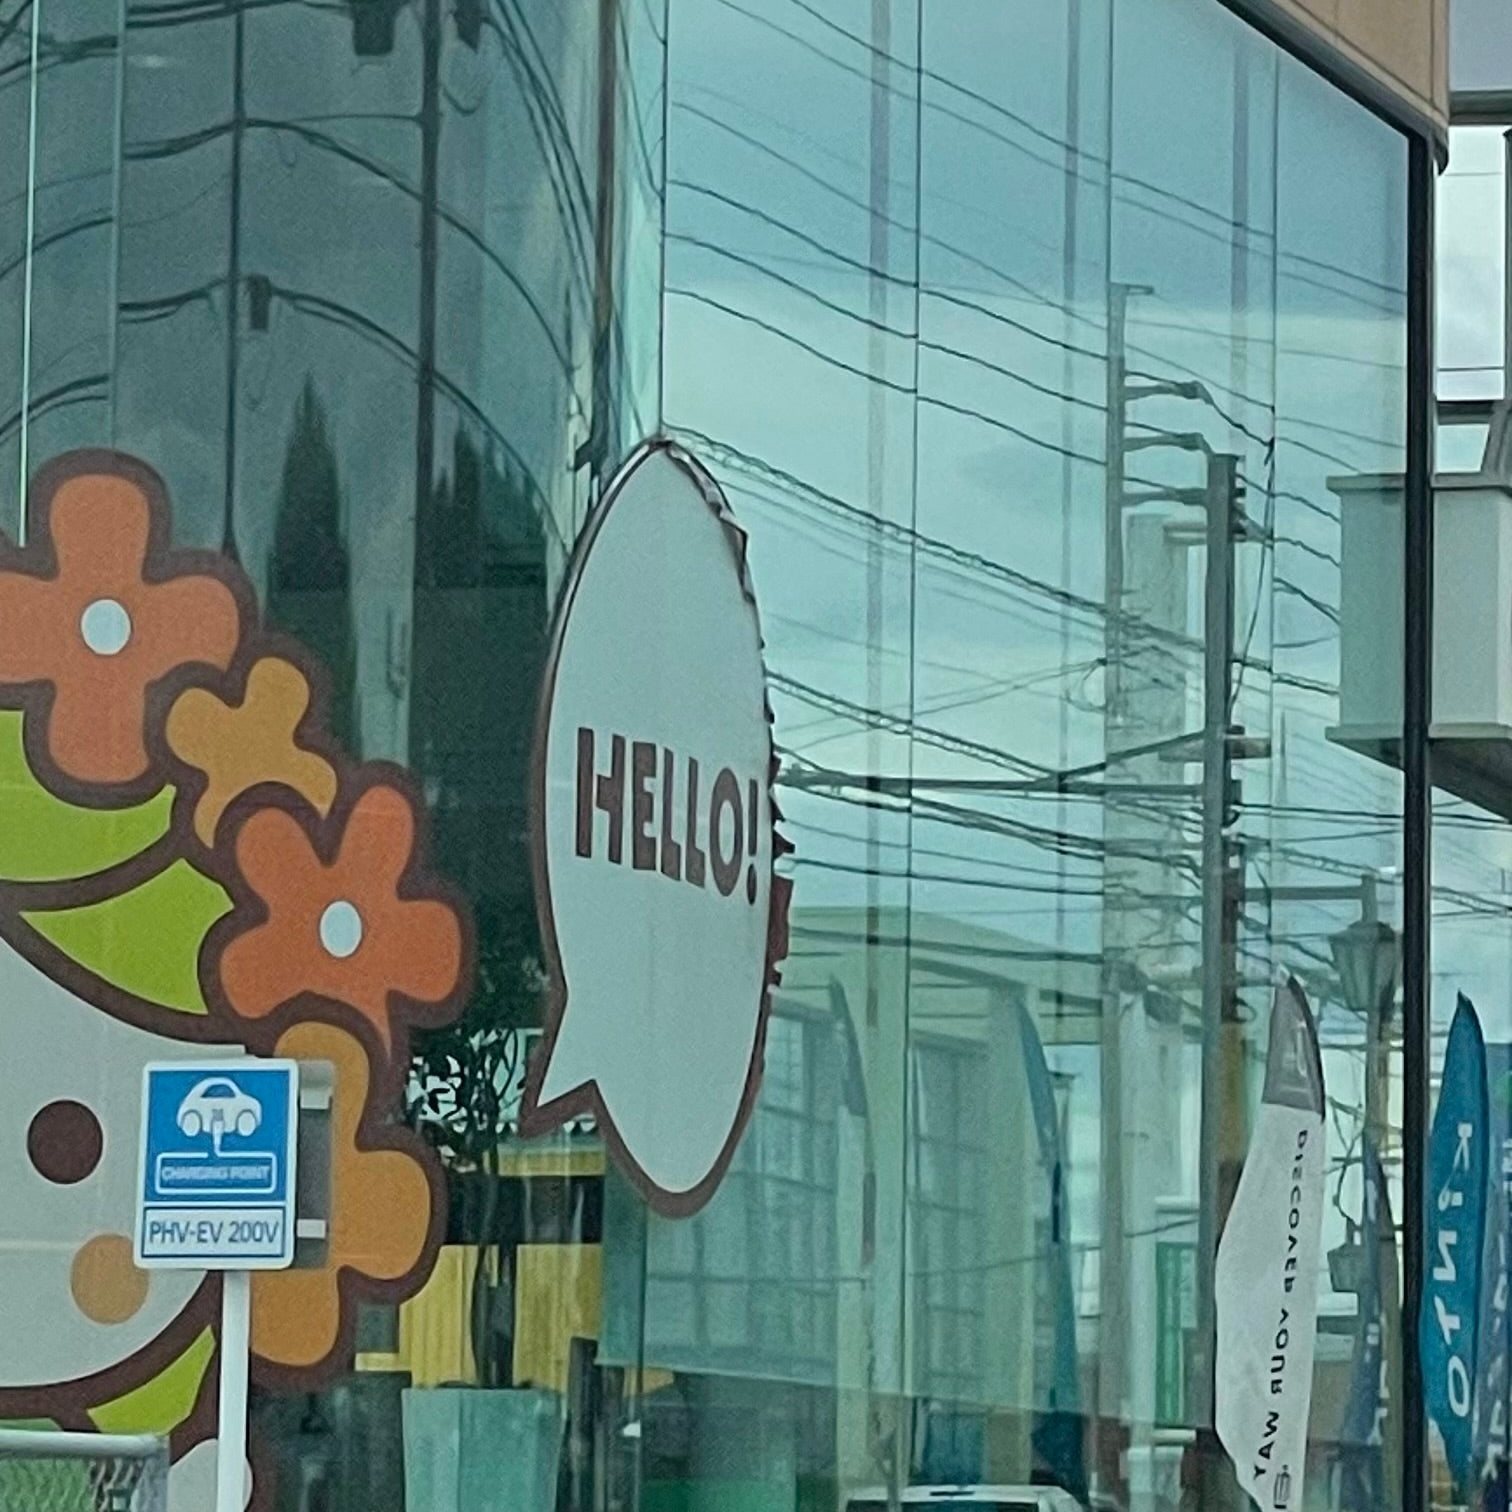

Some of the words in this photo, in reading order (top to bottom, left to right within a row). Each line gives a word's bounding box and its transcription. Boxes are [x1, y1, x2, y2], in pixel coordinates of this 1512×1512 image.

[576, 726, 758, 906] HELLO!
[230, 1165, 271, 1182] POINT
[150, 1220, 224, 1244] PHV-EV
[228, 1220, 280, 1244] 200V
